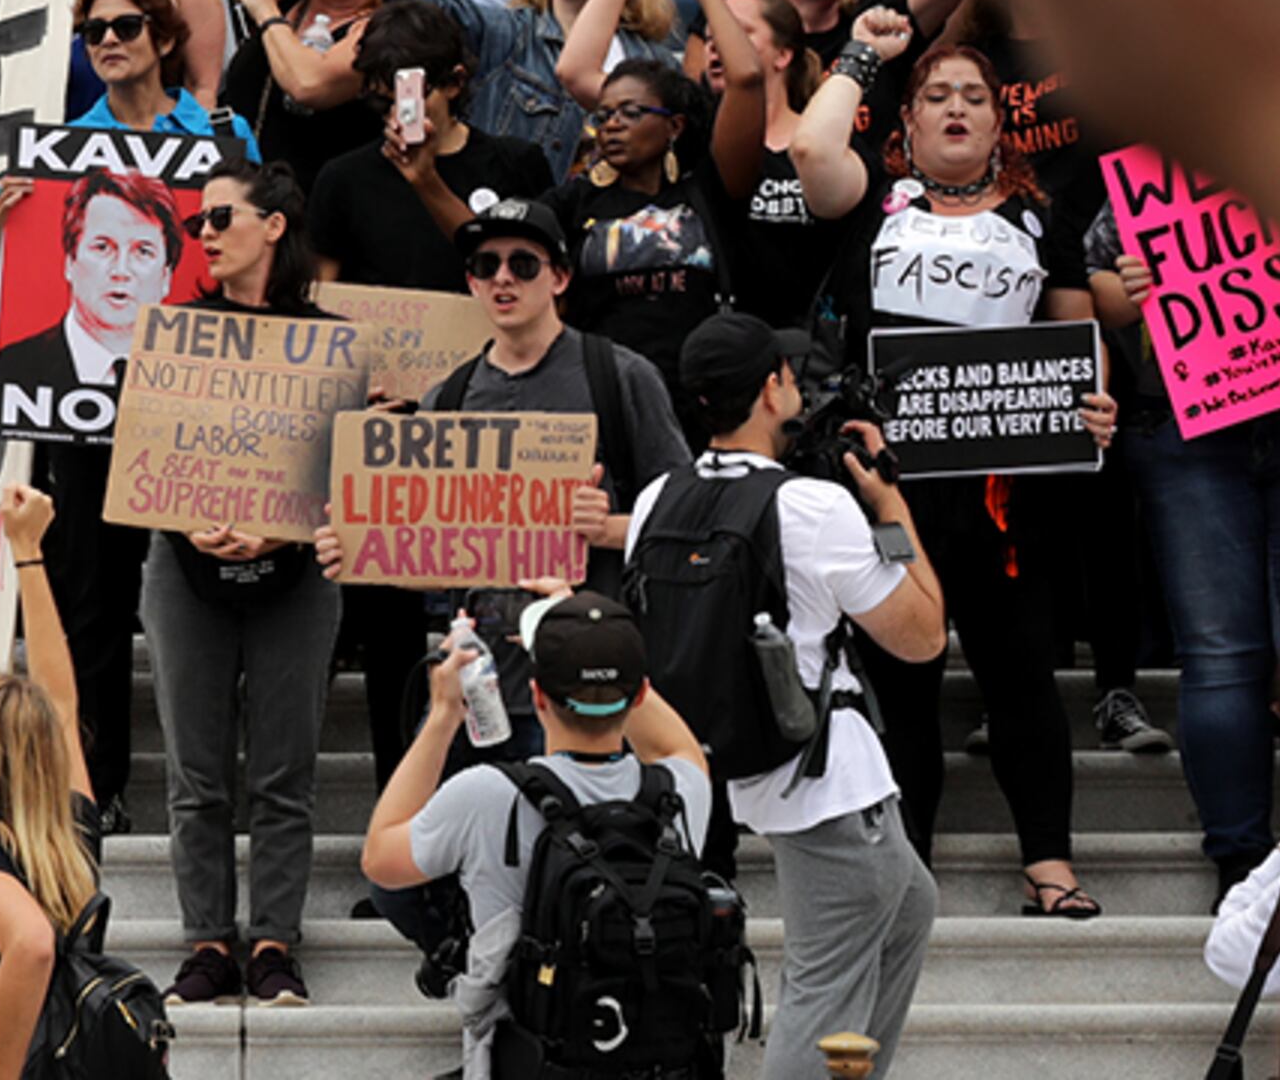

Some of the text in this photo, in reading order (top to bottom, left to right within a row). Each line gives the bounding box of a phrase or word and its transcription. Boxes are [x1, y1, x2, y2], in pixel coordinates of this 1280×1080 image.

[18, 127, 222, 181] KAVA
[132, 359, 361, 414] NOT ENTITLED
[953, 356, 1094, 388] AND BALANCES
[896, 385, 1074, 417] ARE DISAPPEARING
[951, 416, 993, 439] OUR
[996, 412, 1045, 436] VERY
[1049, 408, 1089, 433] EYE
[127, 448, 151, 474] A
[161, 453, 223, 481] SEAT
[363, 417, 520, 471] BRETT
[128, 472, 259, 524] SUPREME
[342, 473, 430, 525] LIED
[435, 472, 526, 527] UNDER
[352, 525, 586, 585] ARREST HIM!
